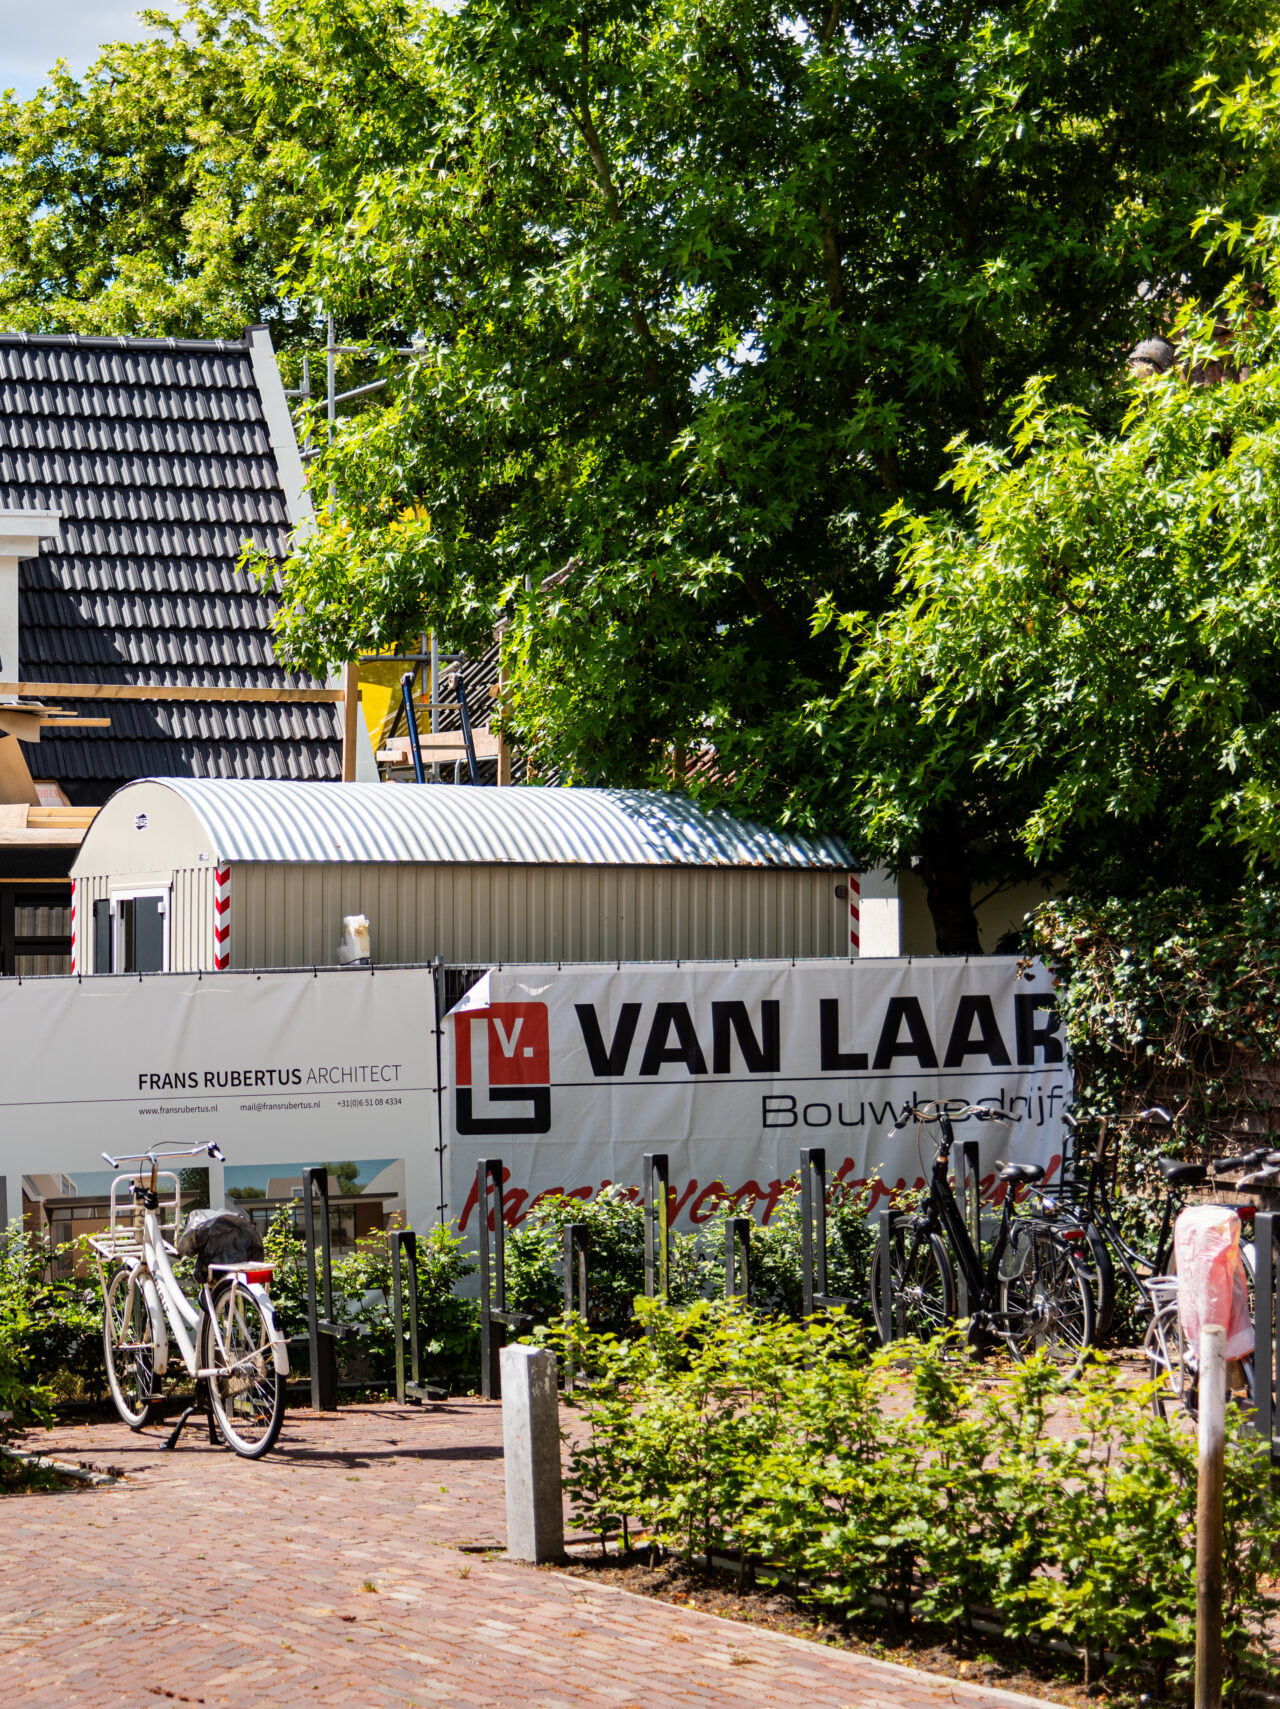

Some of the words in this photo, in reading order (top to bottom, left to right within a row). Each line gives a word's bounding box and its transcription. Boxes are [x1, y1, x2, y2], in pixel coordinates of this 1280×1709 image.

[574, 999, 781, 1077] VAN
[819, 993, 1064, 1072] LAAR
[138, 1071, 199, 1090] FRANS
[203, 1068, 302, 1088] RUBERTUS
[306, 1064, 403, 1085] ARCHITECT
[138, 1103, 218, 1115] www.fransrubertus.nl
[240, 1100, 321, 1112] mail@fransrubertus.nl
